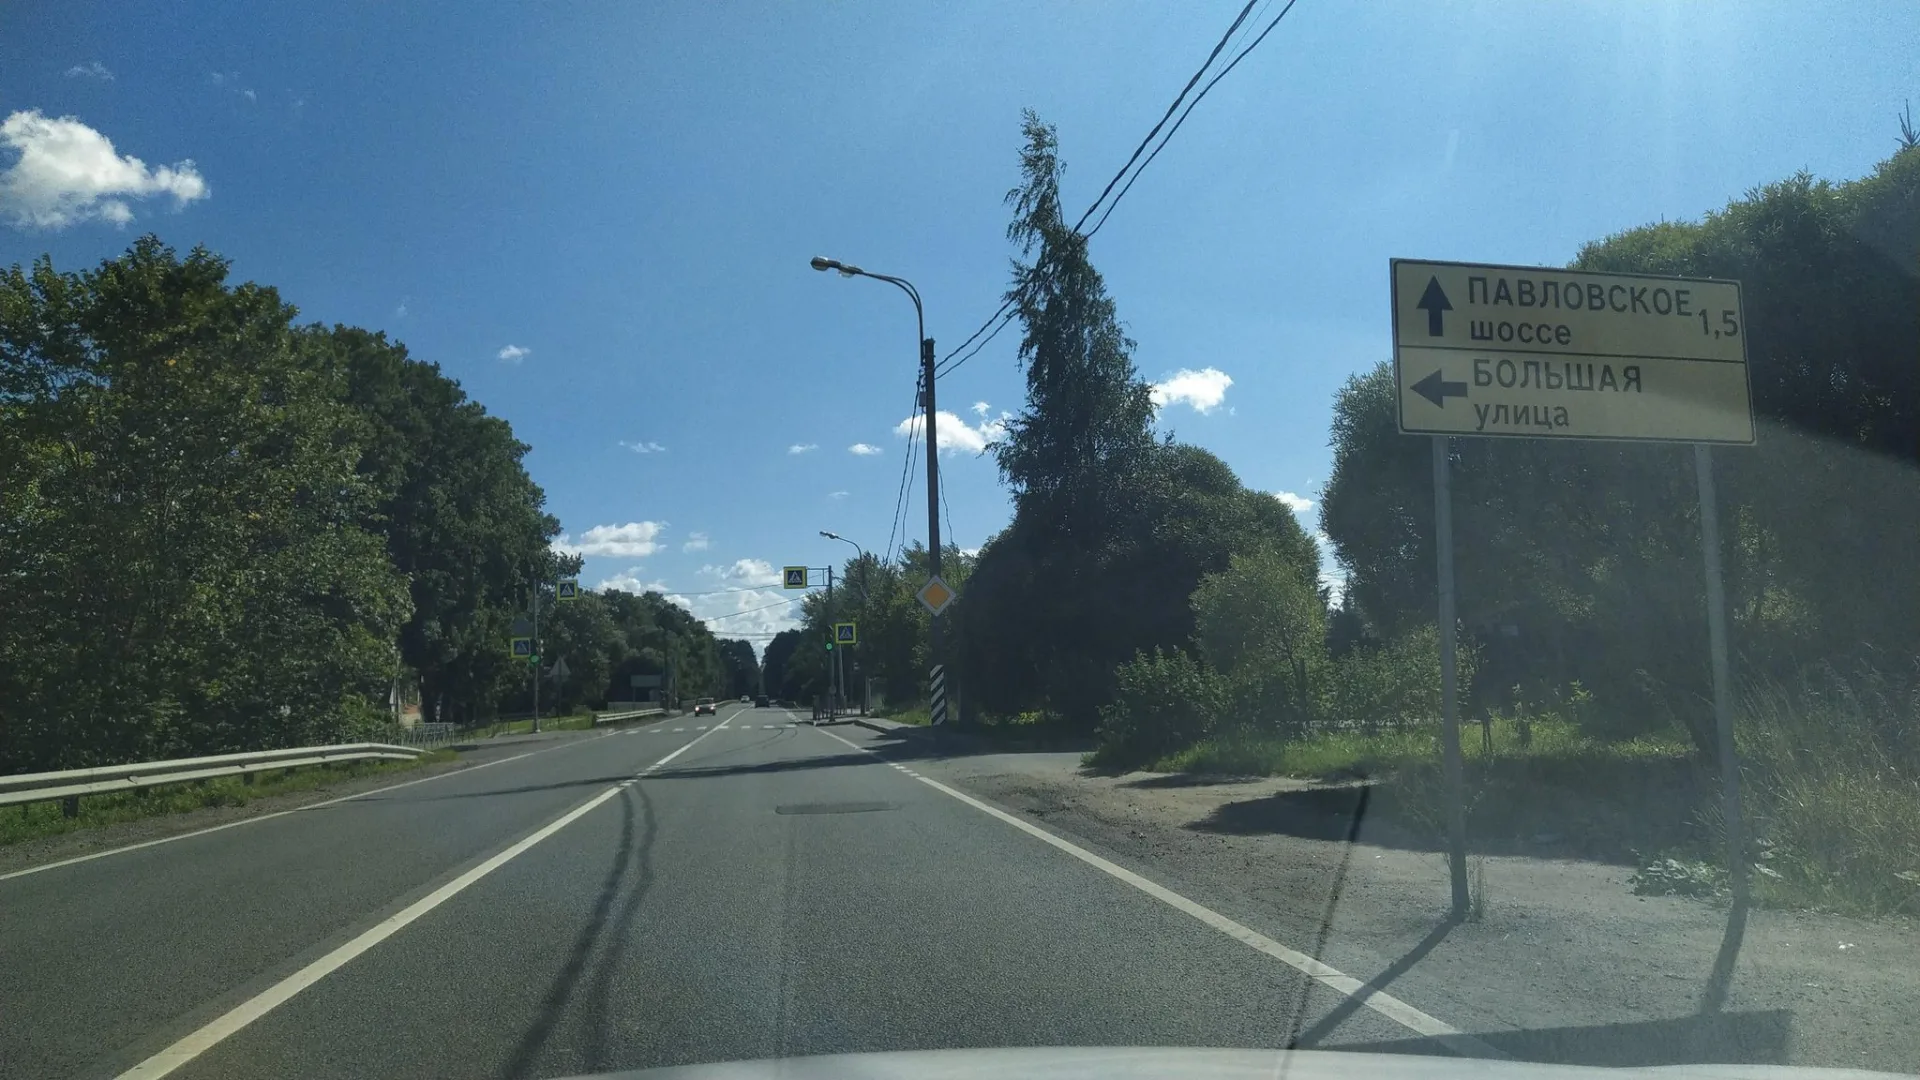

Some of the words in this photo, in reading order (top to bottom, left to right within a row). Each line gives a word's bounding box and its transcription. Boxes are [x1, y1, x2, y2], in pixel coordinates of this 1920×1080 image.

[1468, 276, 1693, 317] ПАВЛОВСКОЕ
[1470, 320, 1572, 345] шоссе
[1699, 309, 1738, 339] 1,5
[1473, 359, 1642, 392] БОЛЬШАЯ
[1474, 402, 1570, 430] улица
